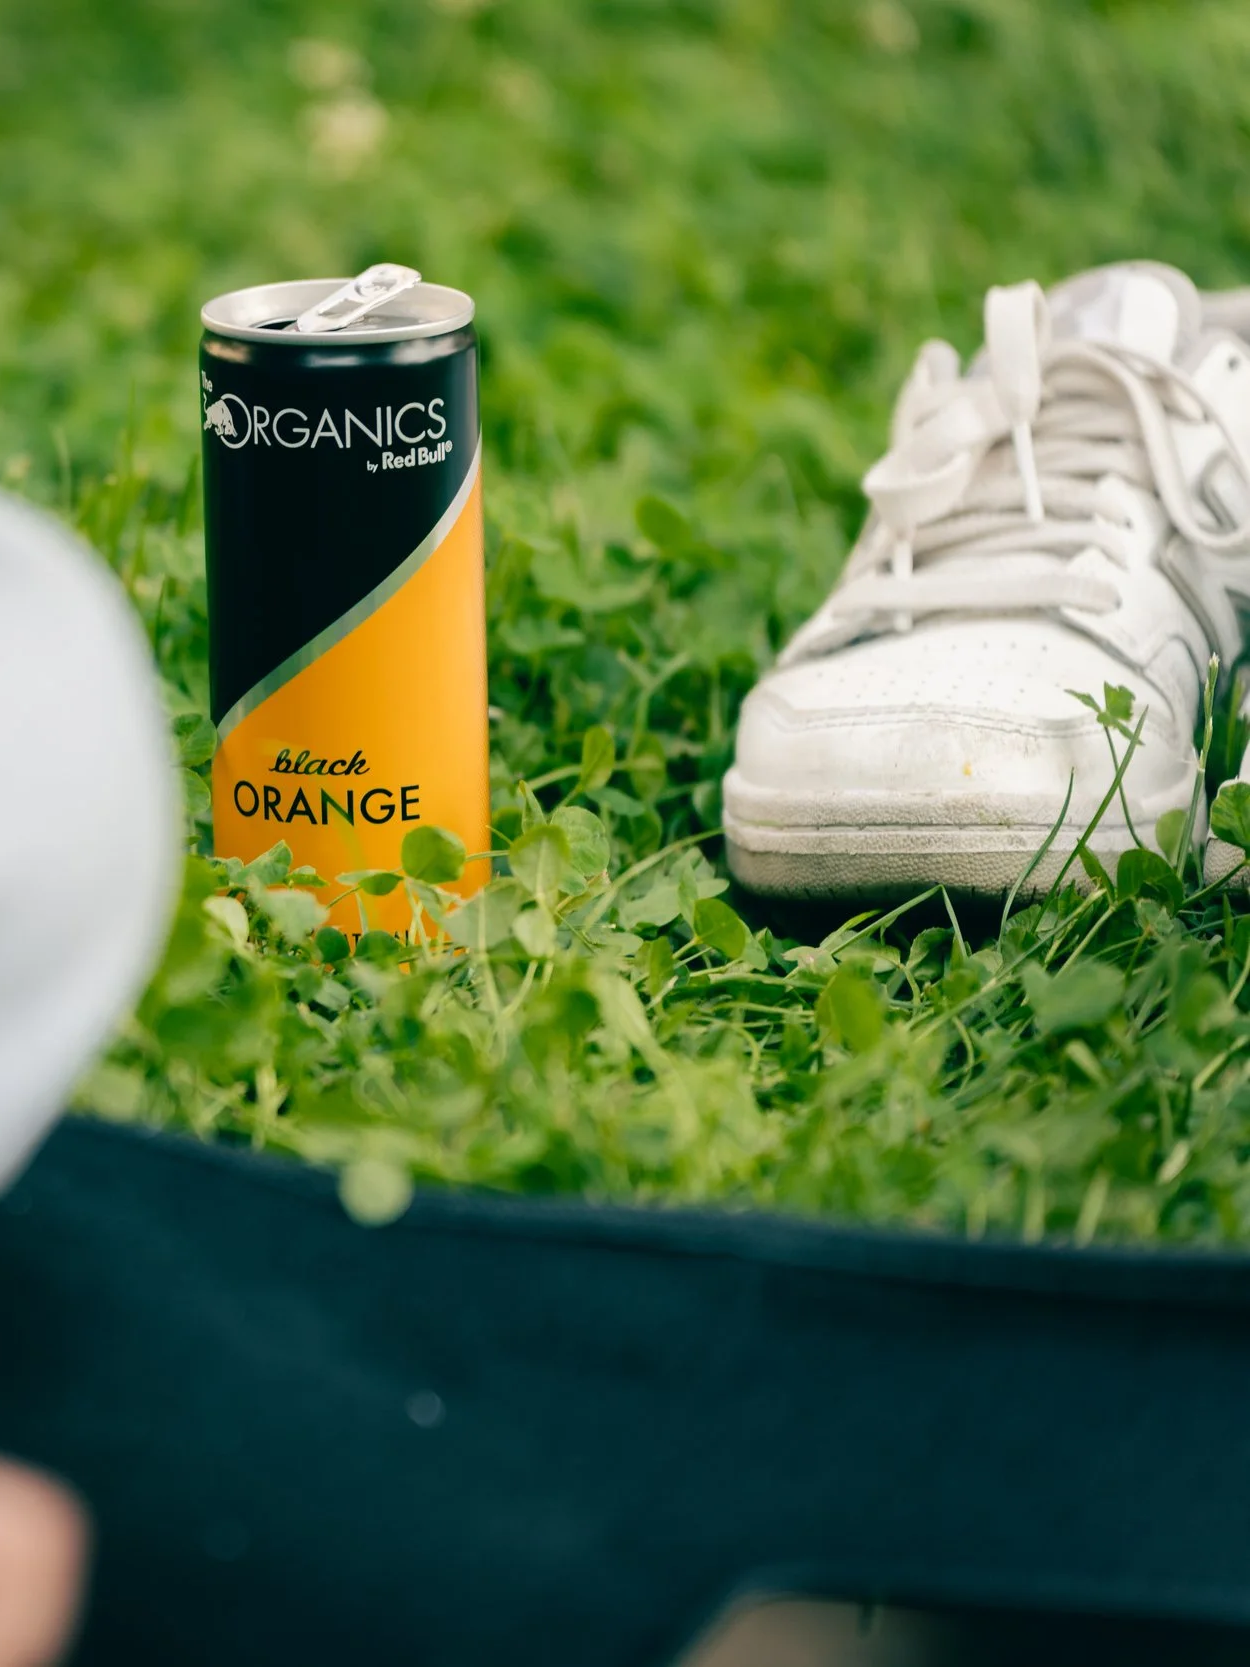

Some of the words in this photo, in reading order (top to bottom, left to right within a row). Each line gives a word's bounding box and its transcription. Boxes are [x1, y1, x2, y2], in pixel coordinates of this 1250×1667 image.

[201, 369, 213, 392] The
[220, 393, 446, 449] ORGANICS
[366, 460, 379, 473] by
[382, 447, 416, 470] Red
[268, 748, 370, 776] black
[234, 780, 421, 826] ORANGE
